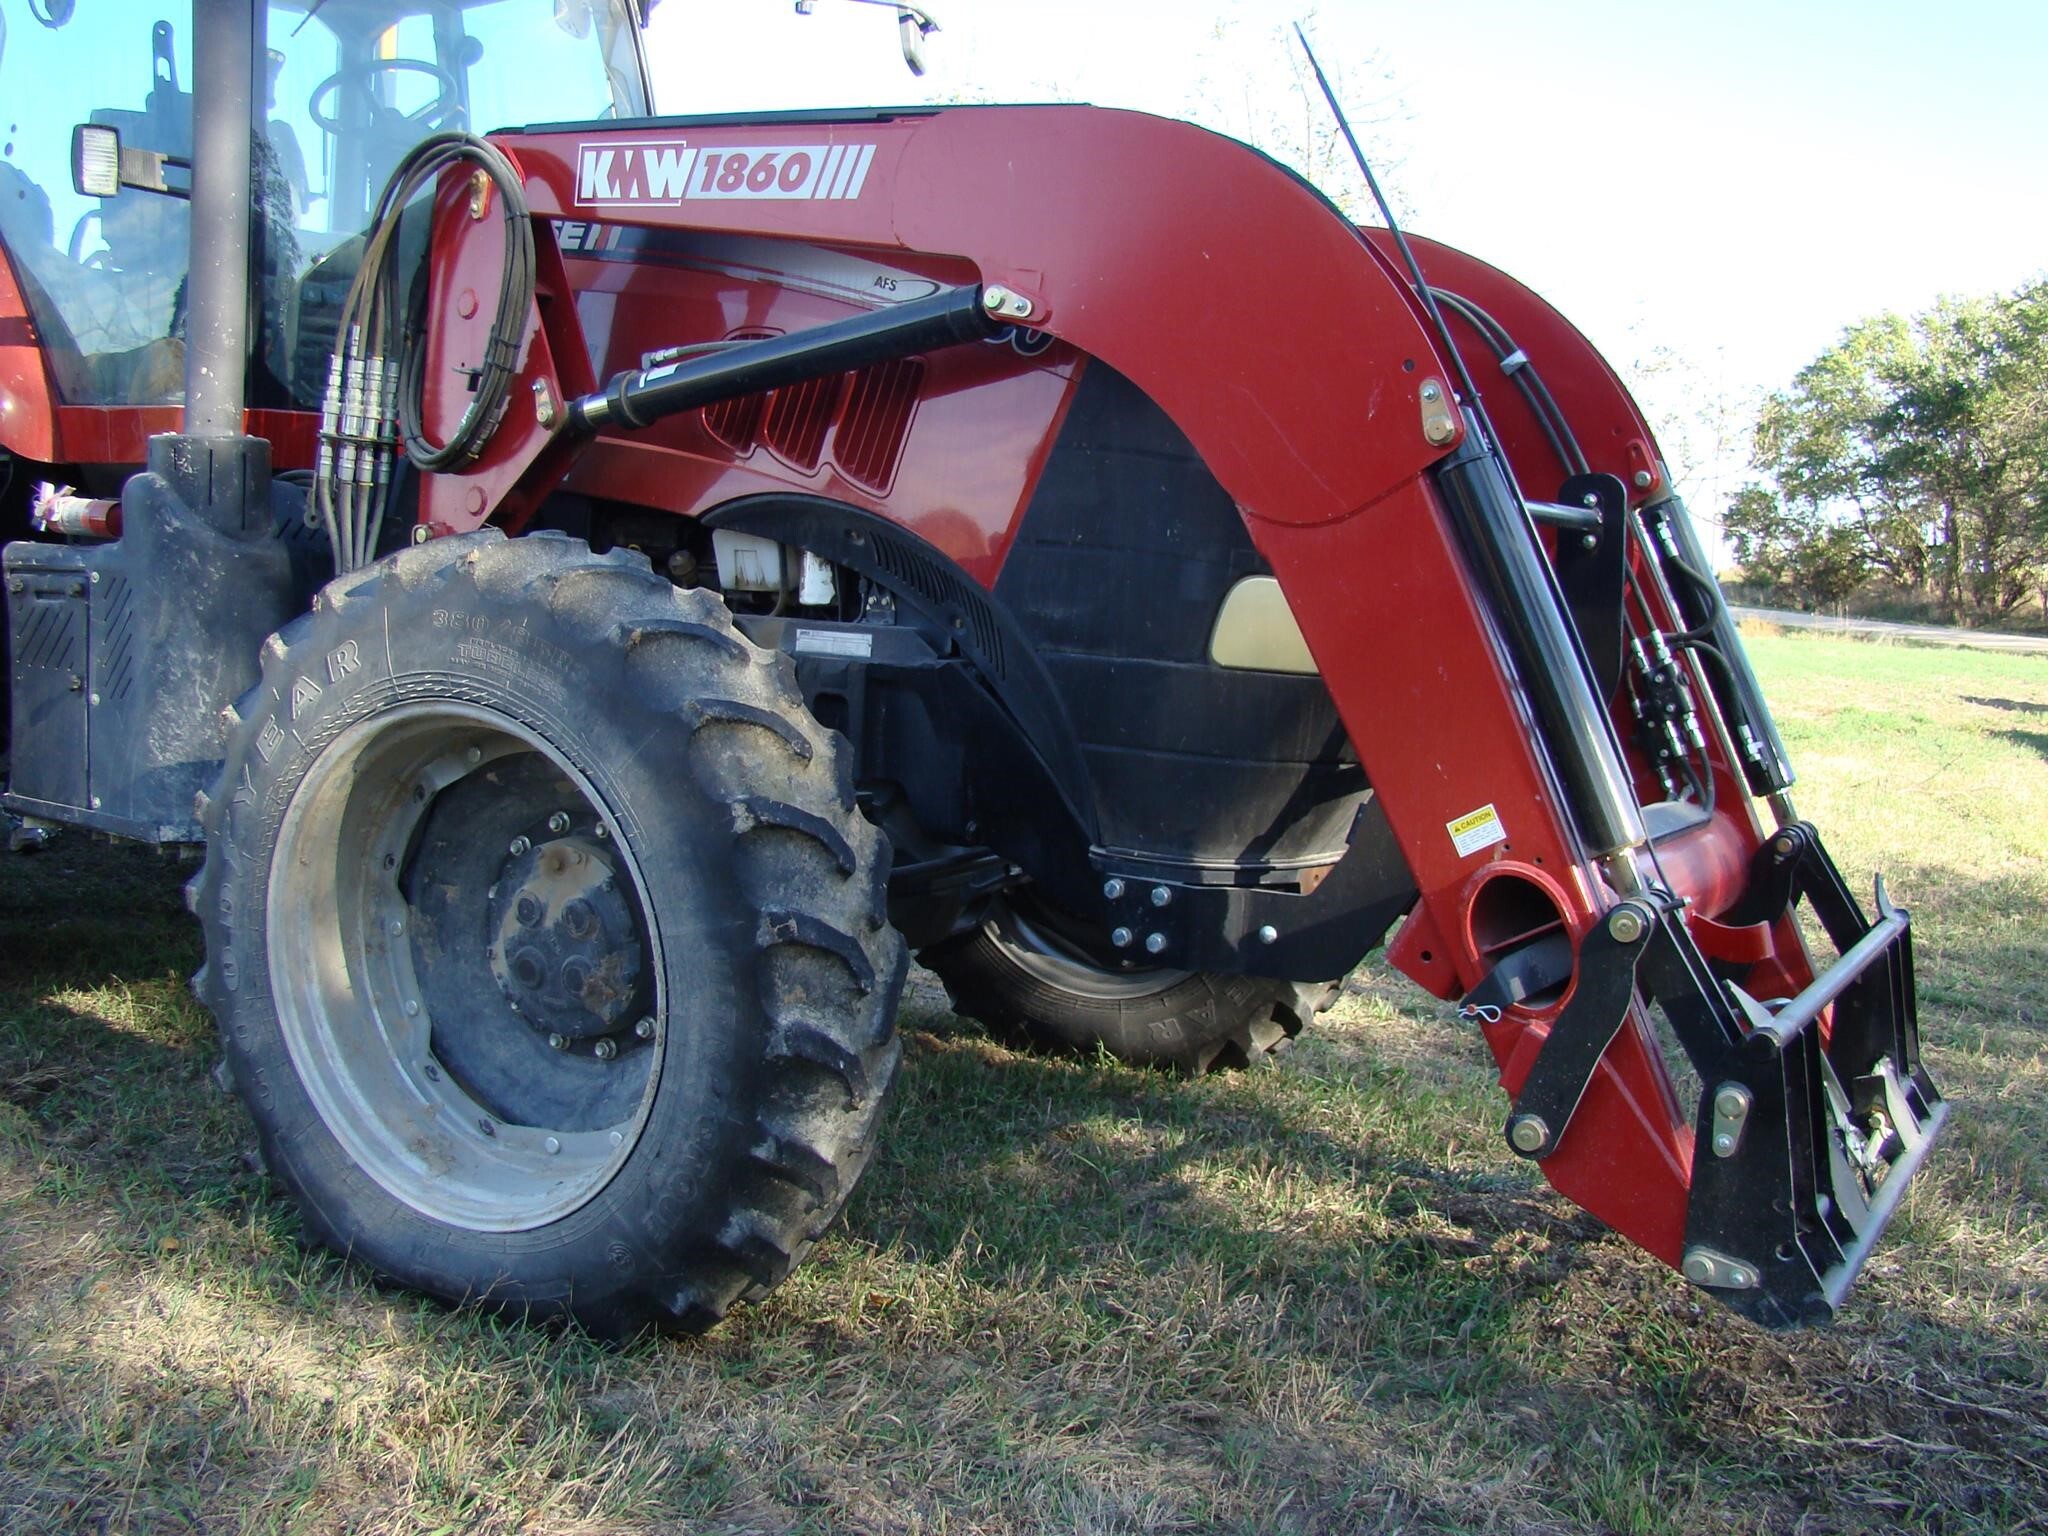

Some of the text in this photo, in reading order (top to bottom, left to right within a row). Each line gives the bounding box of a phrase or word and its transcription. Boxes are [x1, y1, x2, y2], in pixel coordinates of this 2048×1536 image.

[580, 148, 812, 199] KMW 1860
[874, 275, 898, 292] AFS
[1460, 811, 1492, 830] CAUTION
